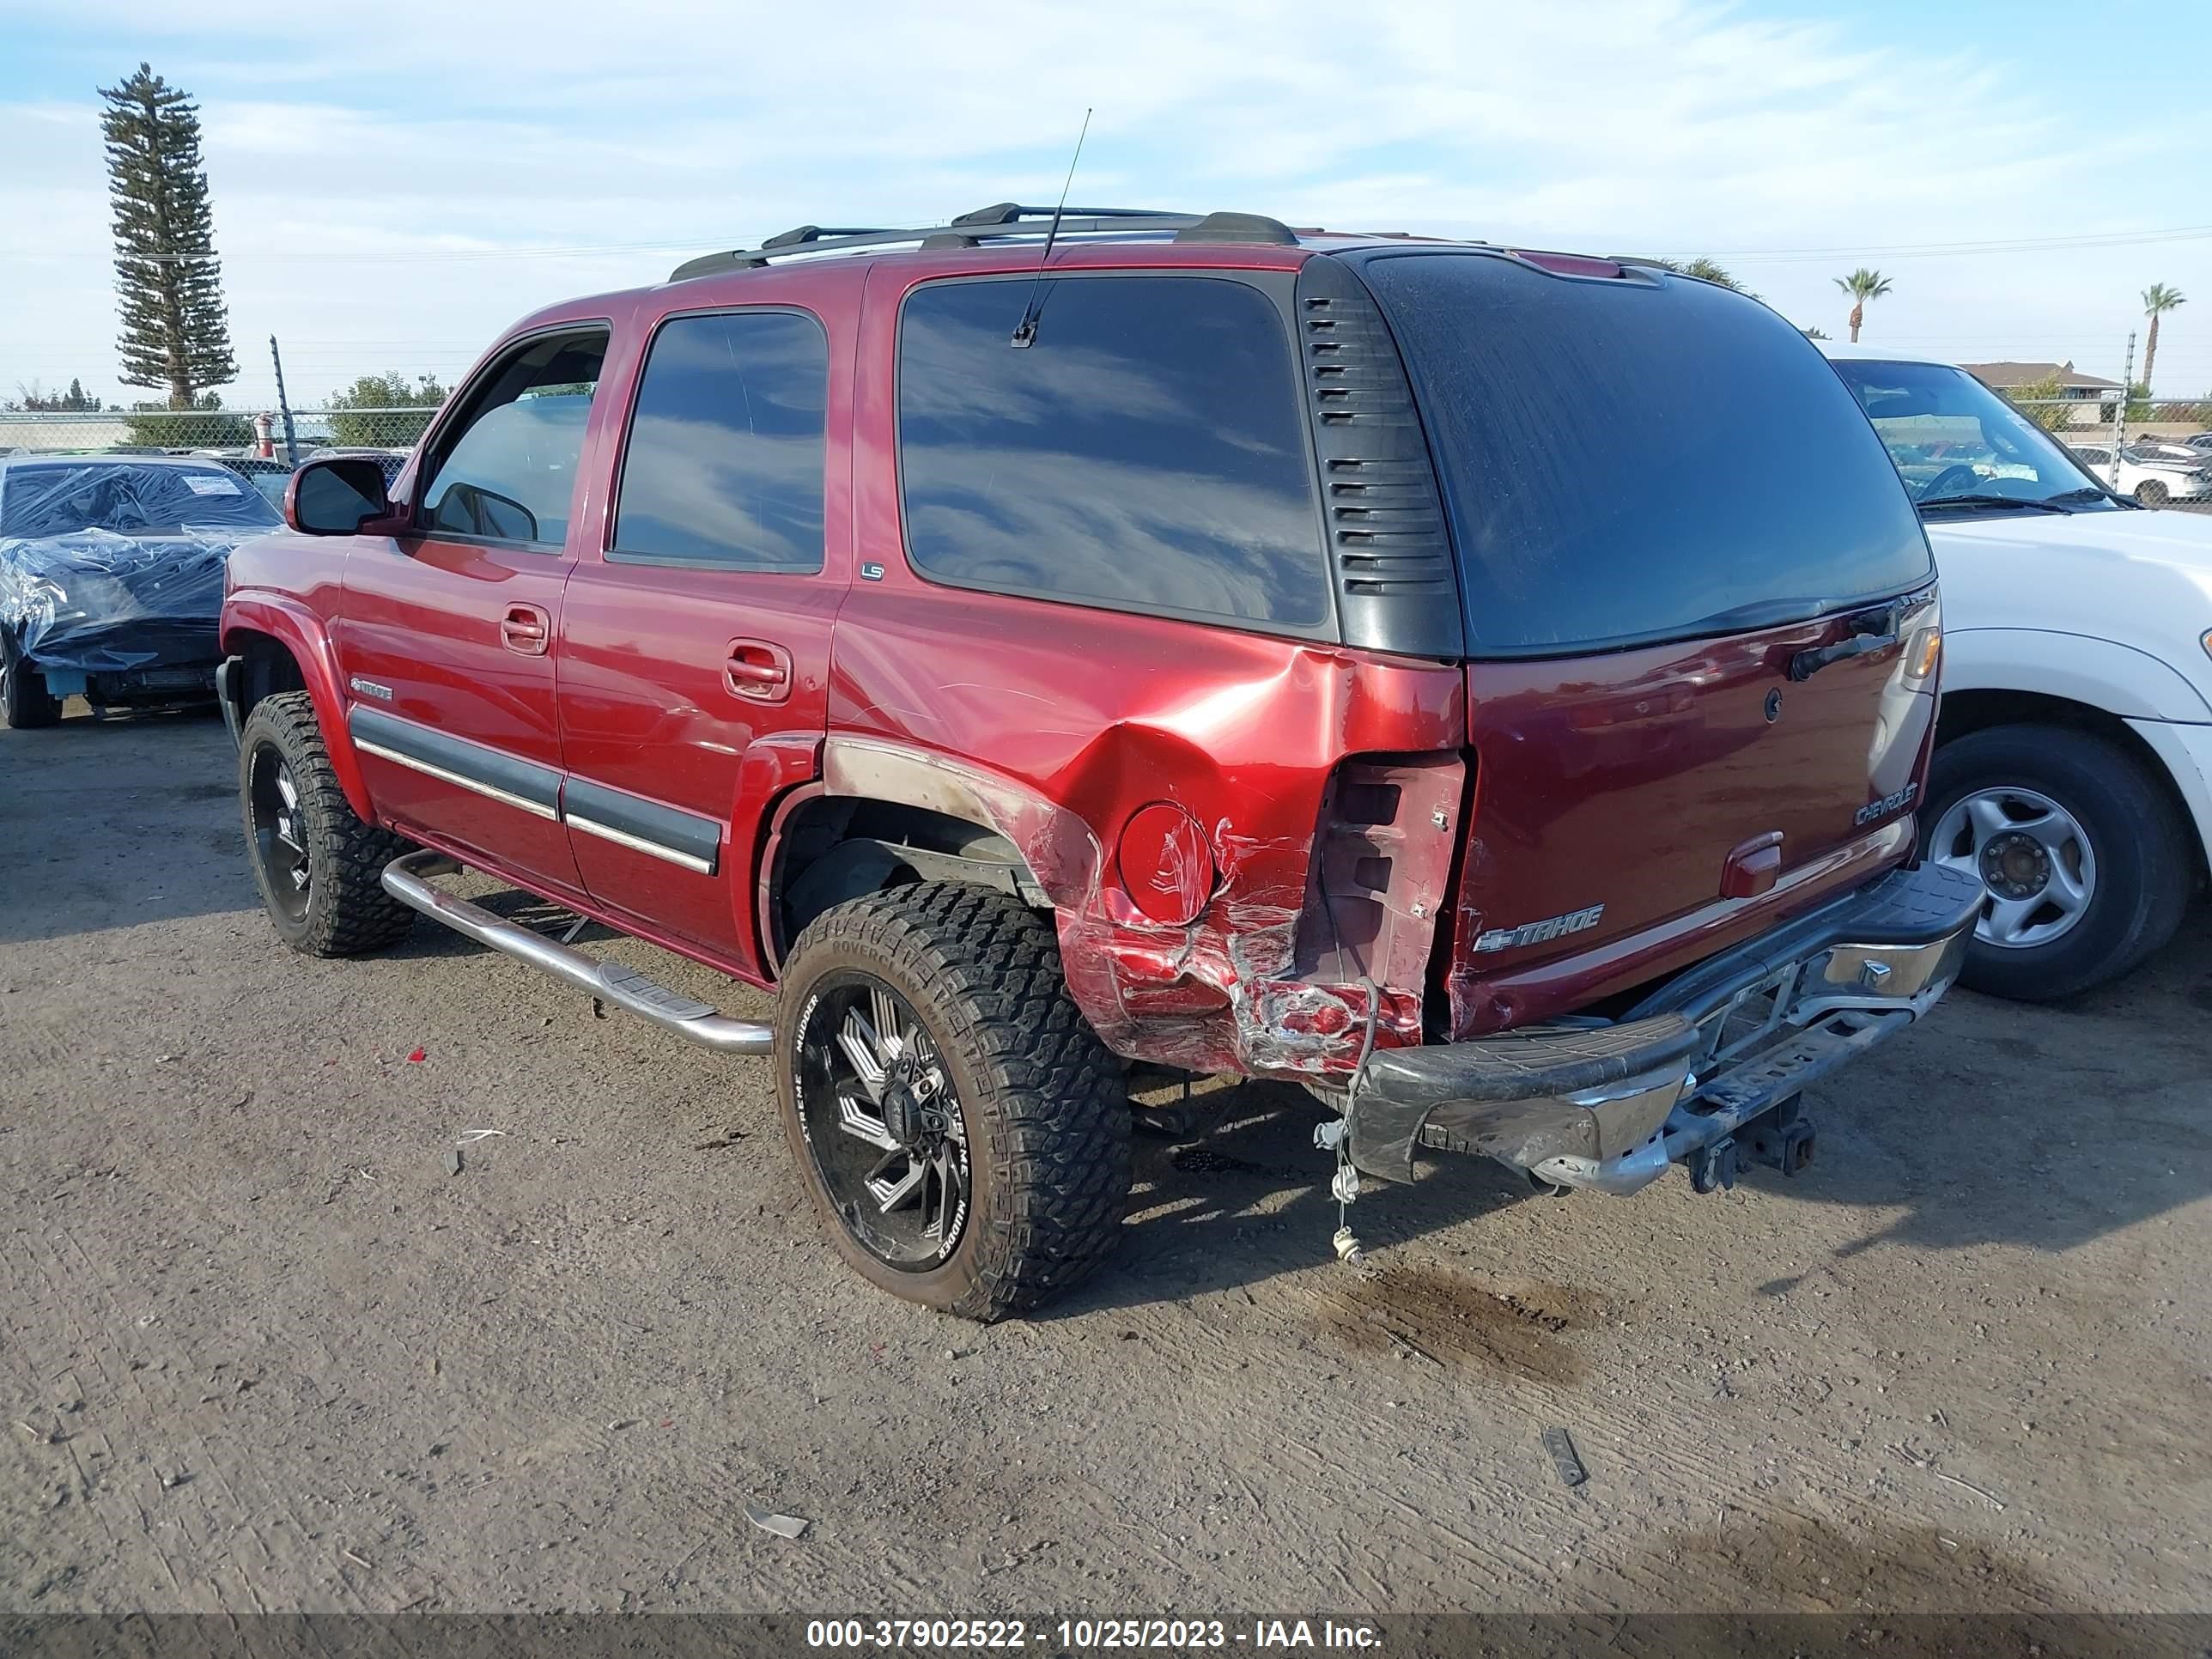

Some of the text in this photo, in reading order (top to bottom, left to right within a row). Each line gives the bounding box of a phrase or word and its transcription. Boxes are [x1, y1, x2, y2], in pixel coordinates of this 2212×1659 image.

[861, 563, 882, 579] LS
[1517, 902, 1605, 946] TAHOE
[795, 994, 820, 1144] XTREME MUDDER
[937, 1097, 969, 1261] XTREME MUDDER
